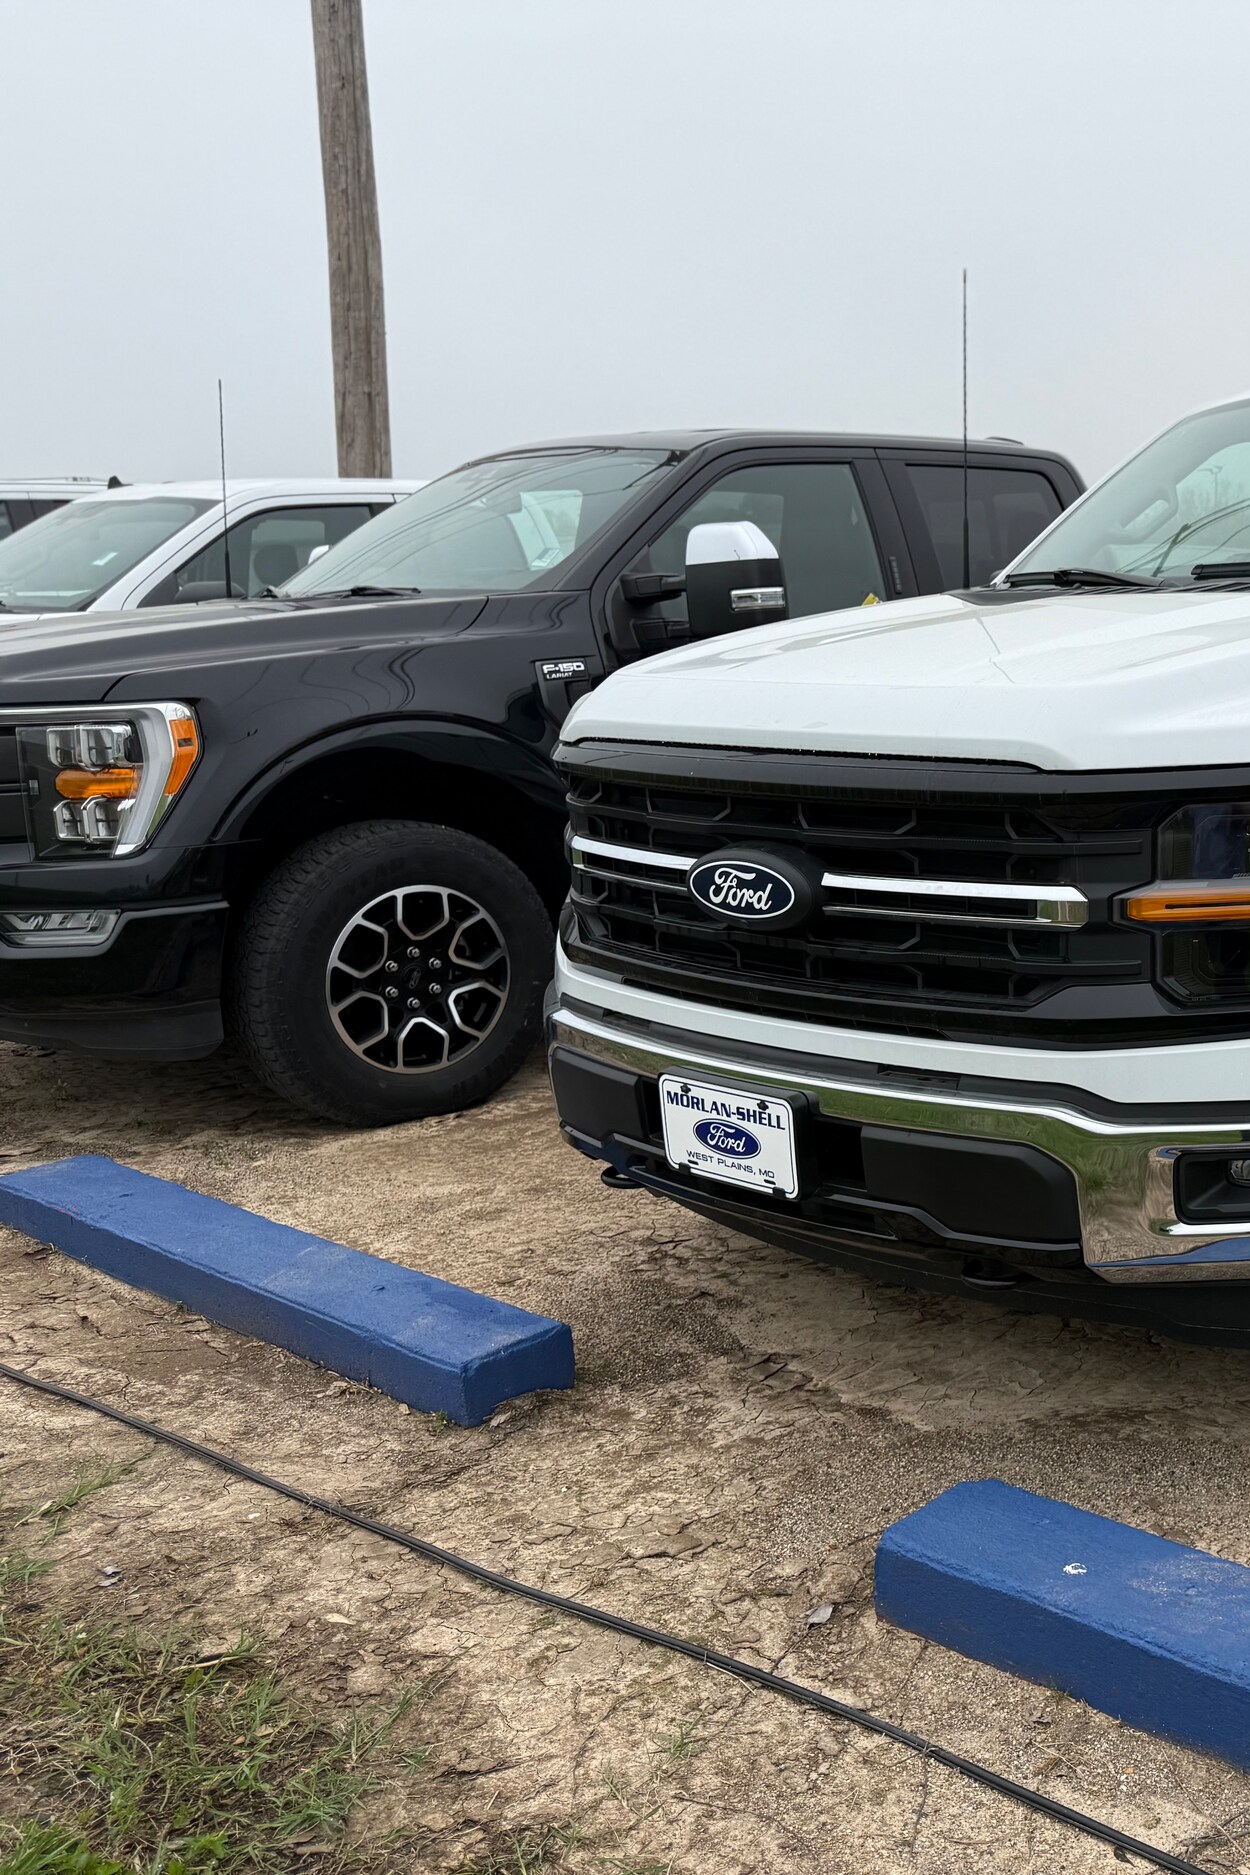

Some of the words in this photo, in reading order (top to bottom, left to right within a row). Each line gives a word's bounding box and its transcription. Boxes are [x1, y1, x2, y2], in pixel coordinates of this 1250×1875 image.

[542, 661, 585, 674] F-150
[709, 867, 773, 911] Ford
[666, 1090, 786, 1131] MORLAN-SHELL
[707, 1123, 746, 1153] Ford
[686, 1149, 715, 1164] WEST
[717, 1157, 756, 1176] PLAINS,
[758, 1167, 776, 1179] MO
